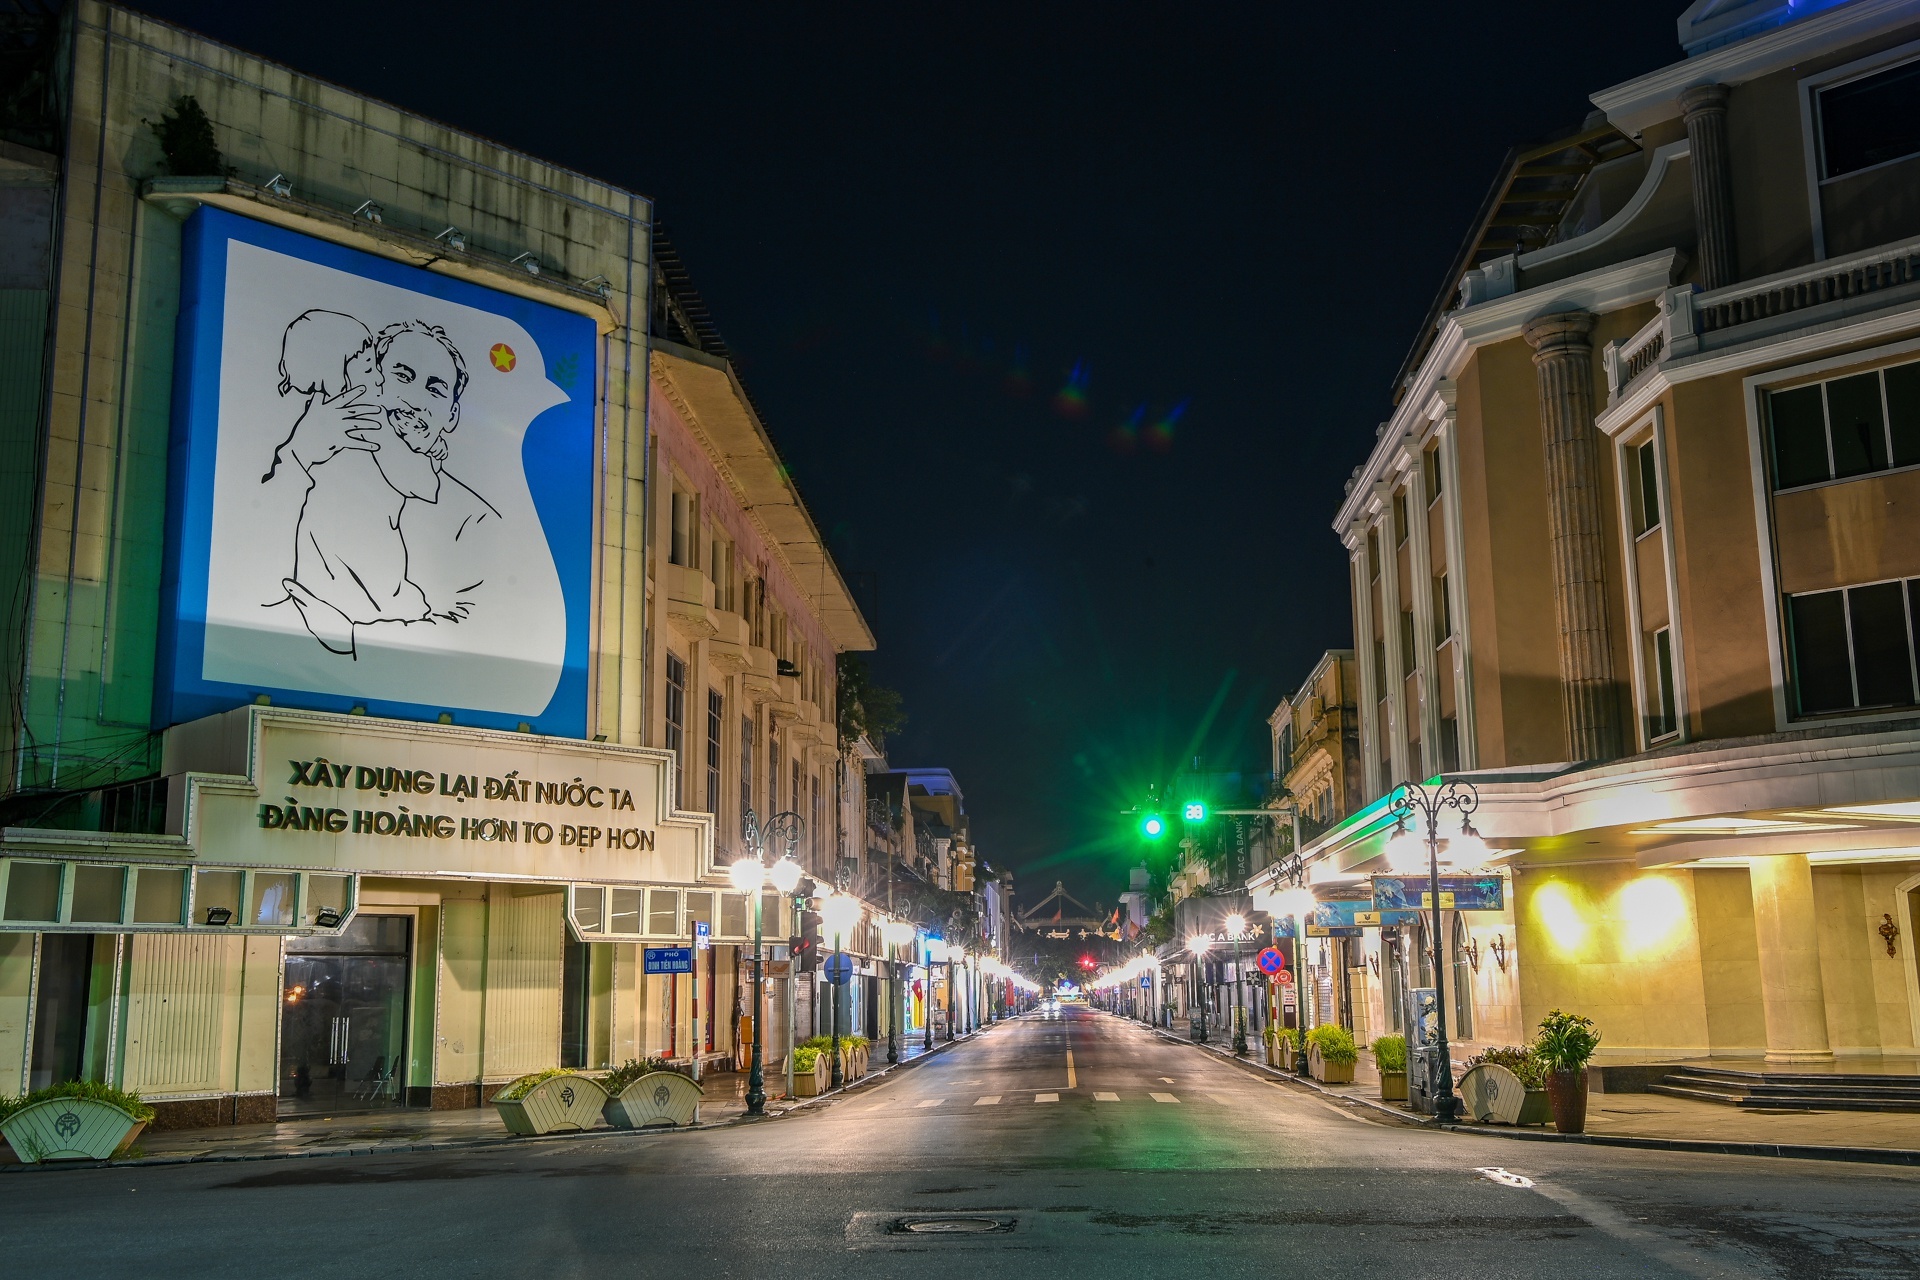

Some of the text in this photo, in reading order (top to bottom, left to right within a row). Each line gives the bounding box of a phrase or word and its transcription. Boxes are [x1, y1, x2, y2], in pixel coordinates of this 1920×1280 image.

[287, 757, 636, 812] XÂY DỰNG LẠI ĐẤT NƯỚC TA
[256, 796, 655, 853] ĐÀNG HOÀNG HƠN TO ĐẸP HƠN
[1235, 820, 1244, 846] BANK
